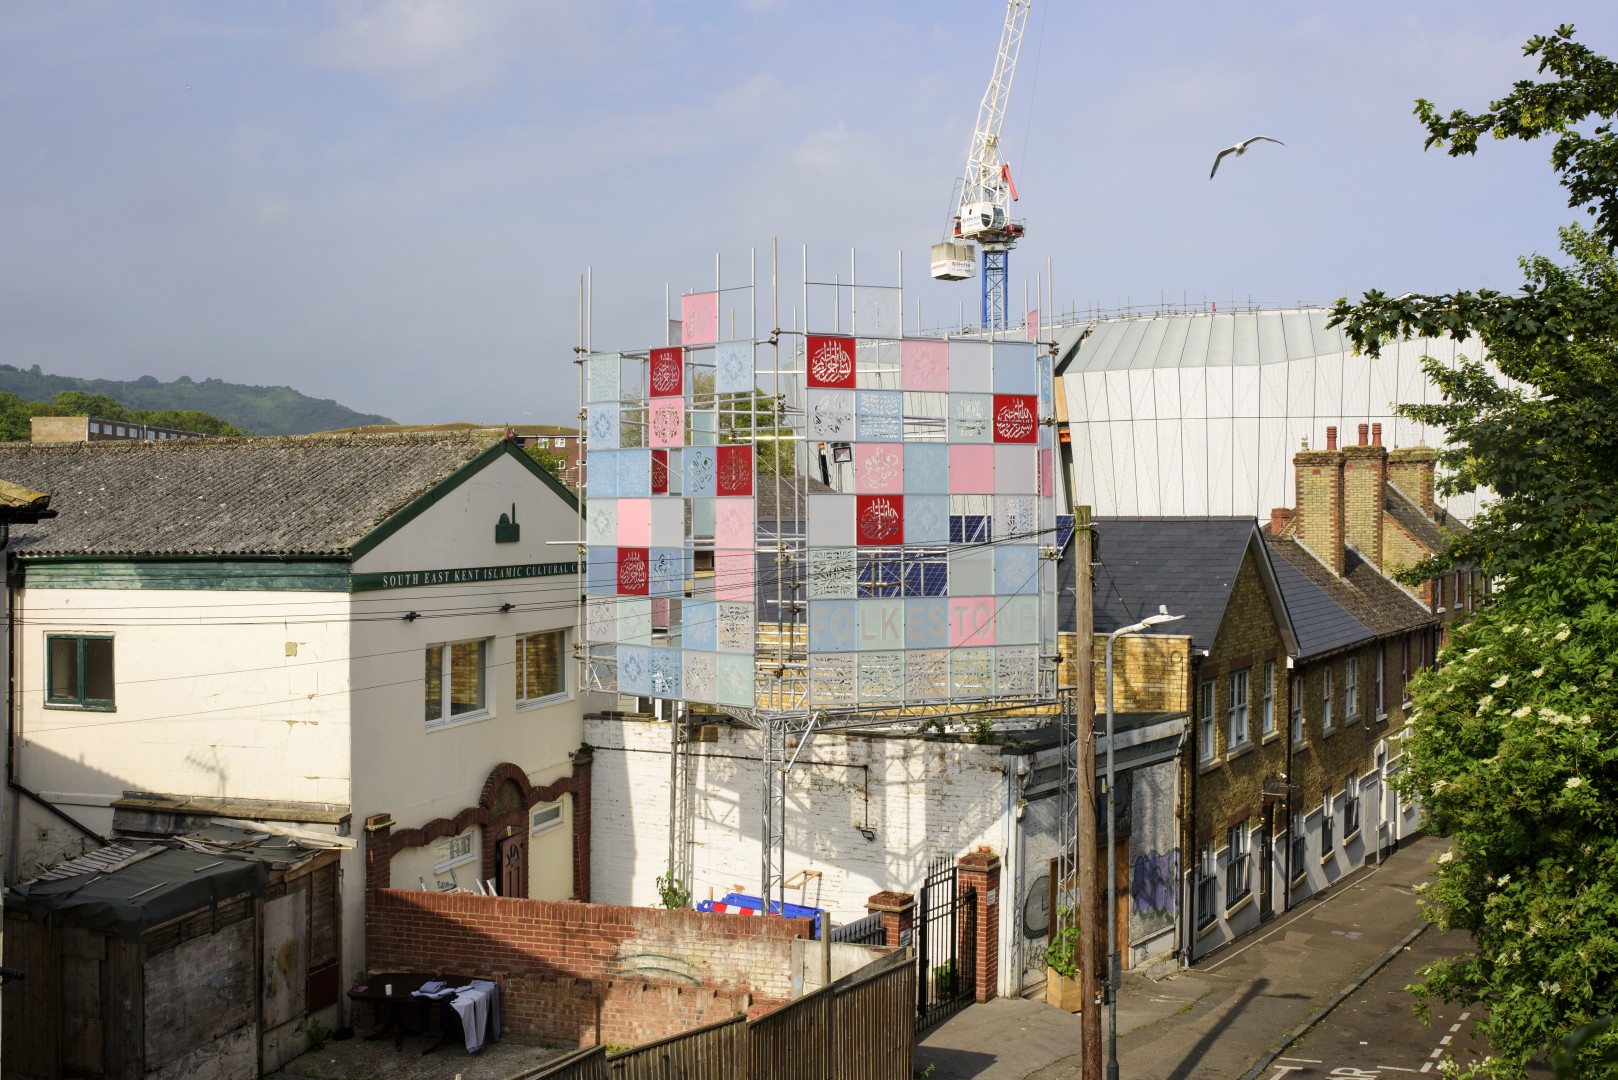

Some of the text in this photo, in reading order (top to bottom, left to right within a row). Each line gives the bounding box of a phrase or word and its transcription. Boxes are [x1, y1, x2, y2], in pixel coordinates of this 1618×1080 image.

[383, 573, 419, 587] SOUTH
[424, 571, 450, 584] EAST
[454, 569, 480, 582] KENT
[484, 566, 523, 580] ISLAMIC
[526, 563, 568, 576] CULTURAL
[813, 603, 1036, 641] FOLKESTONE
